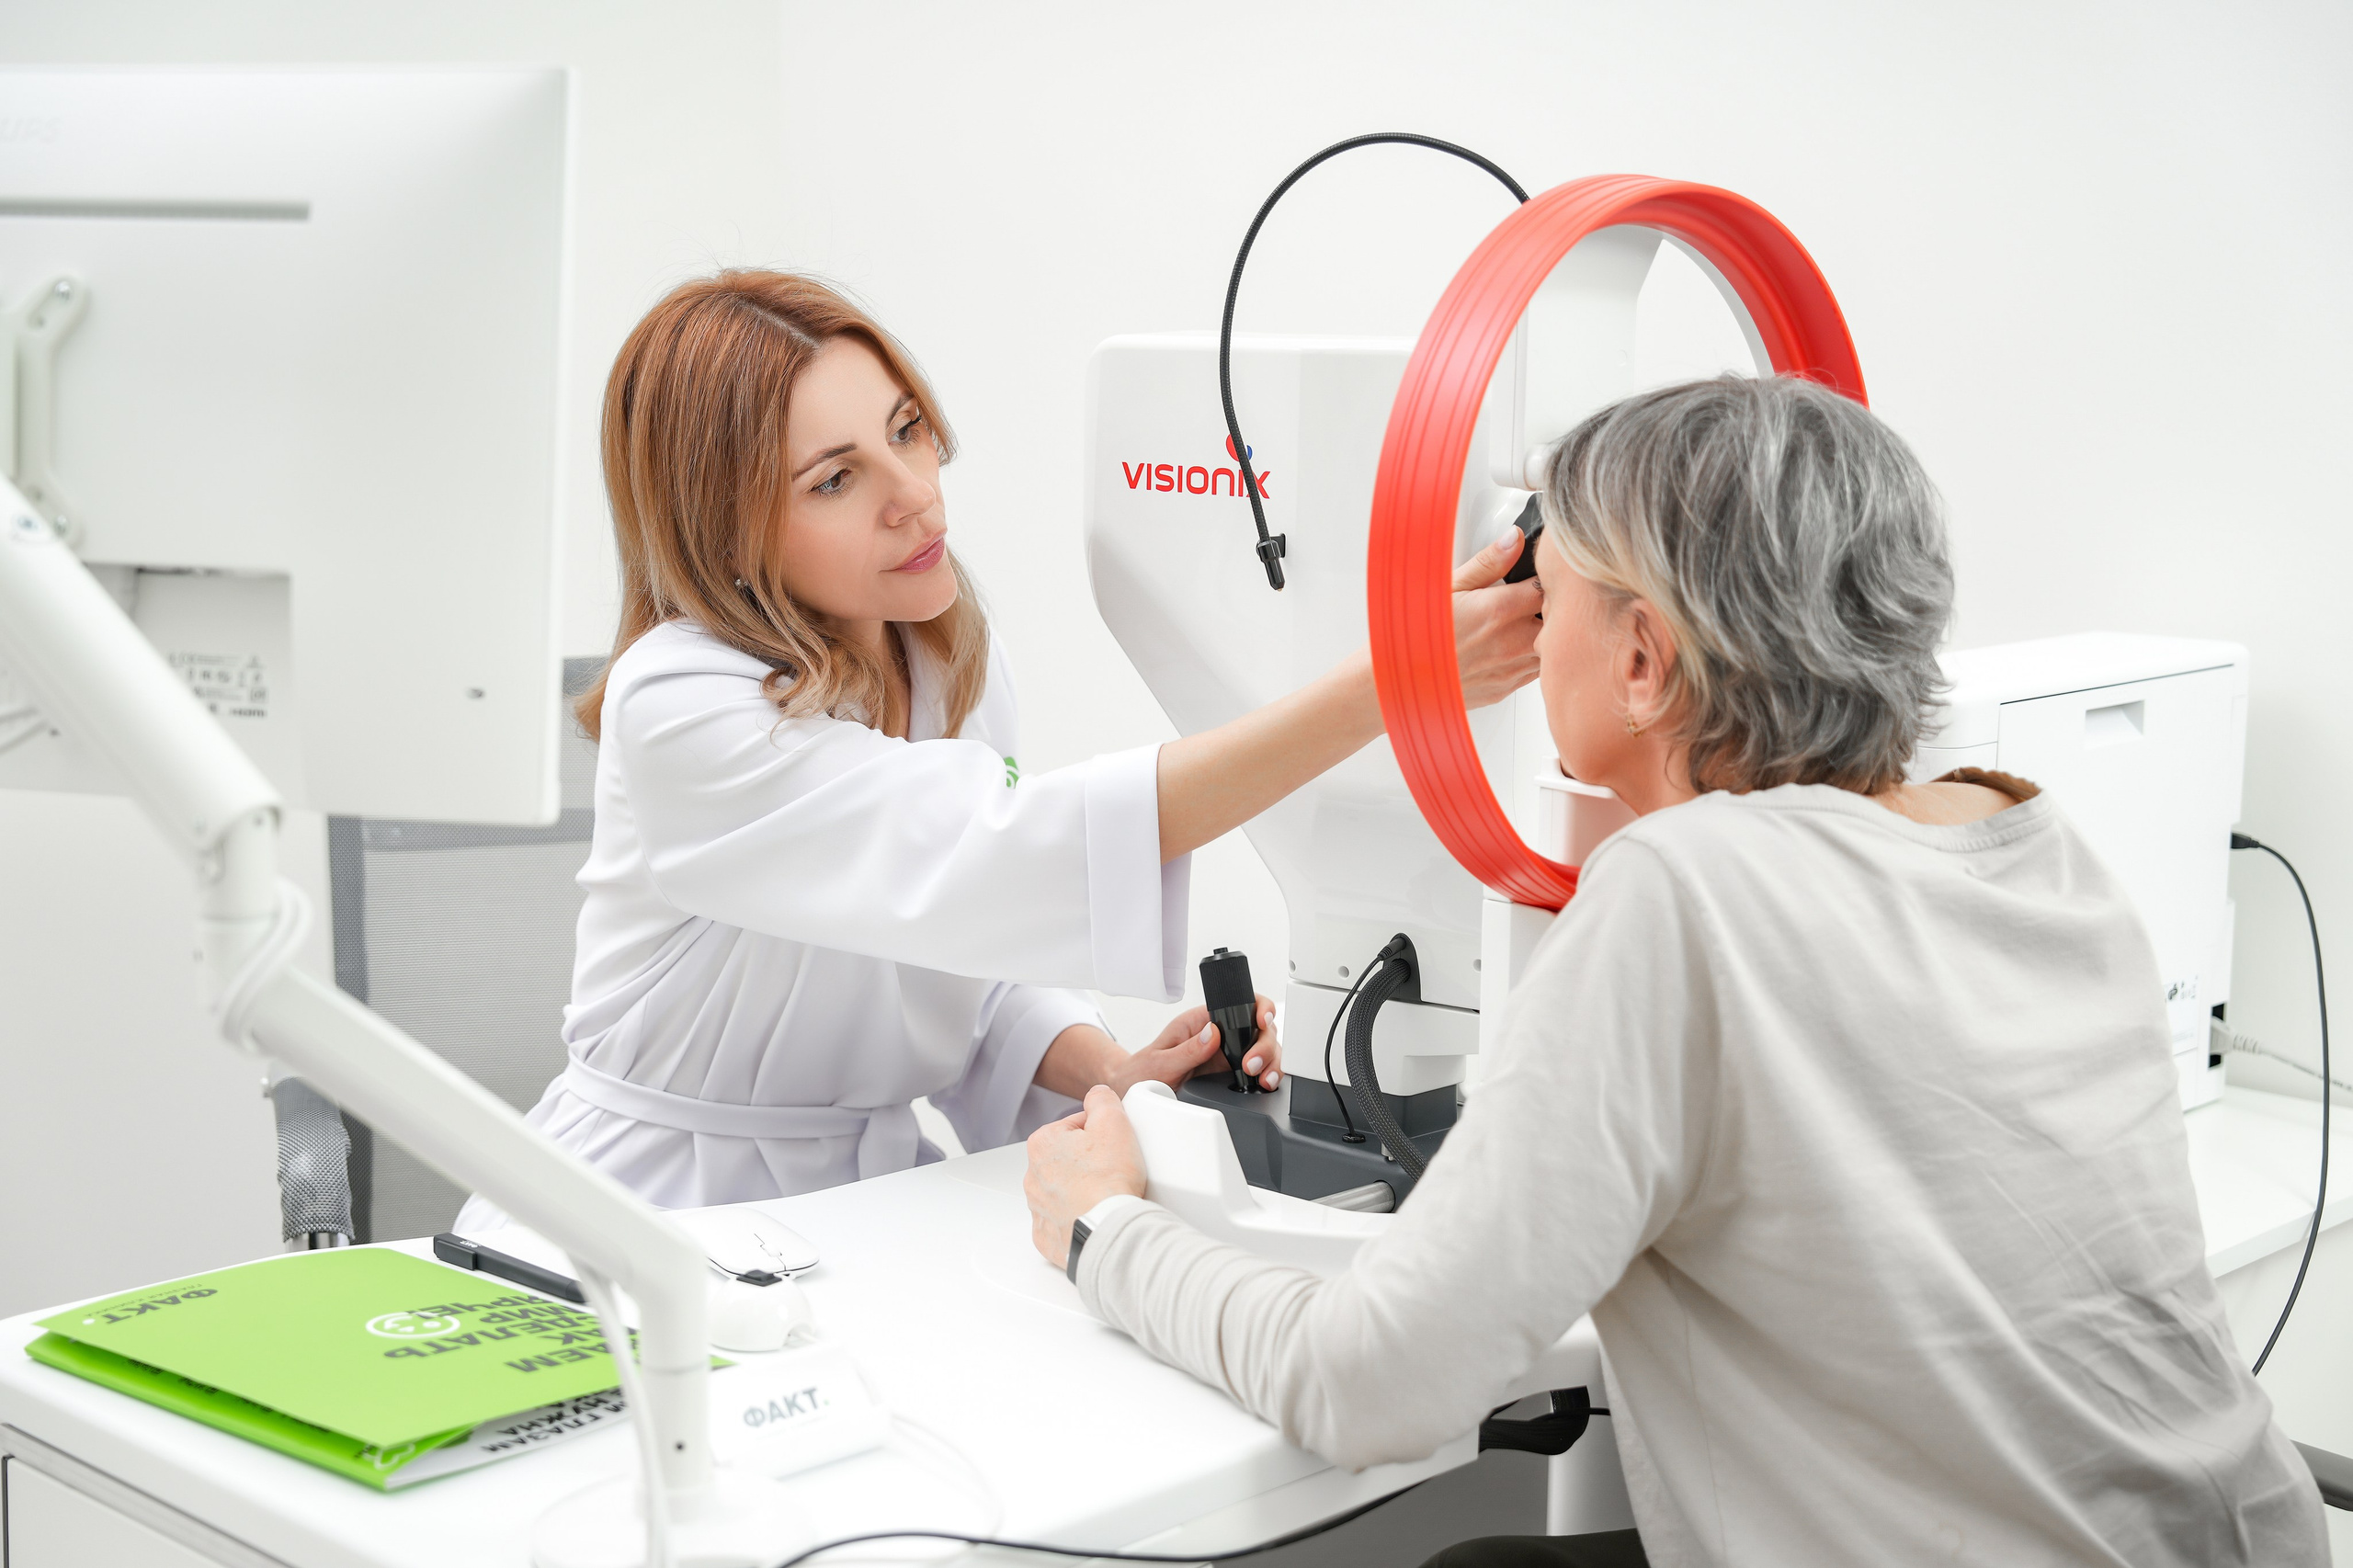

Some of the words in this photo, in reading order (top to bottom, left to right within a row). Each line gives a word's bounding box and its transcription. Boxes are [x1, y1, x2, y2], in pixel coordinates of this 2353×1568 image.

[1122, 461, 1270, 499] VISIONIX
[479, 1304, 588, 1324] МИР
[505, 1339, 641, 1373] АЕМ
[481, 1413, 603, 1453] ГЛАЗАМ
